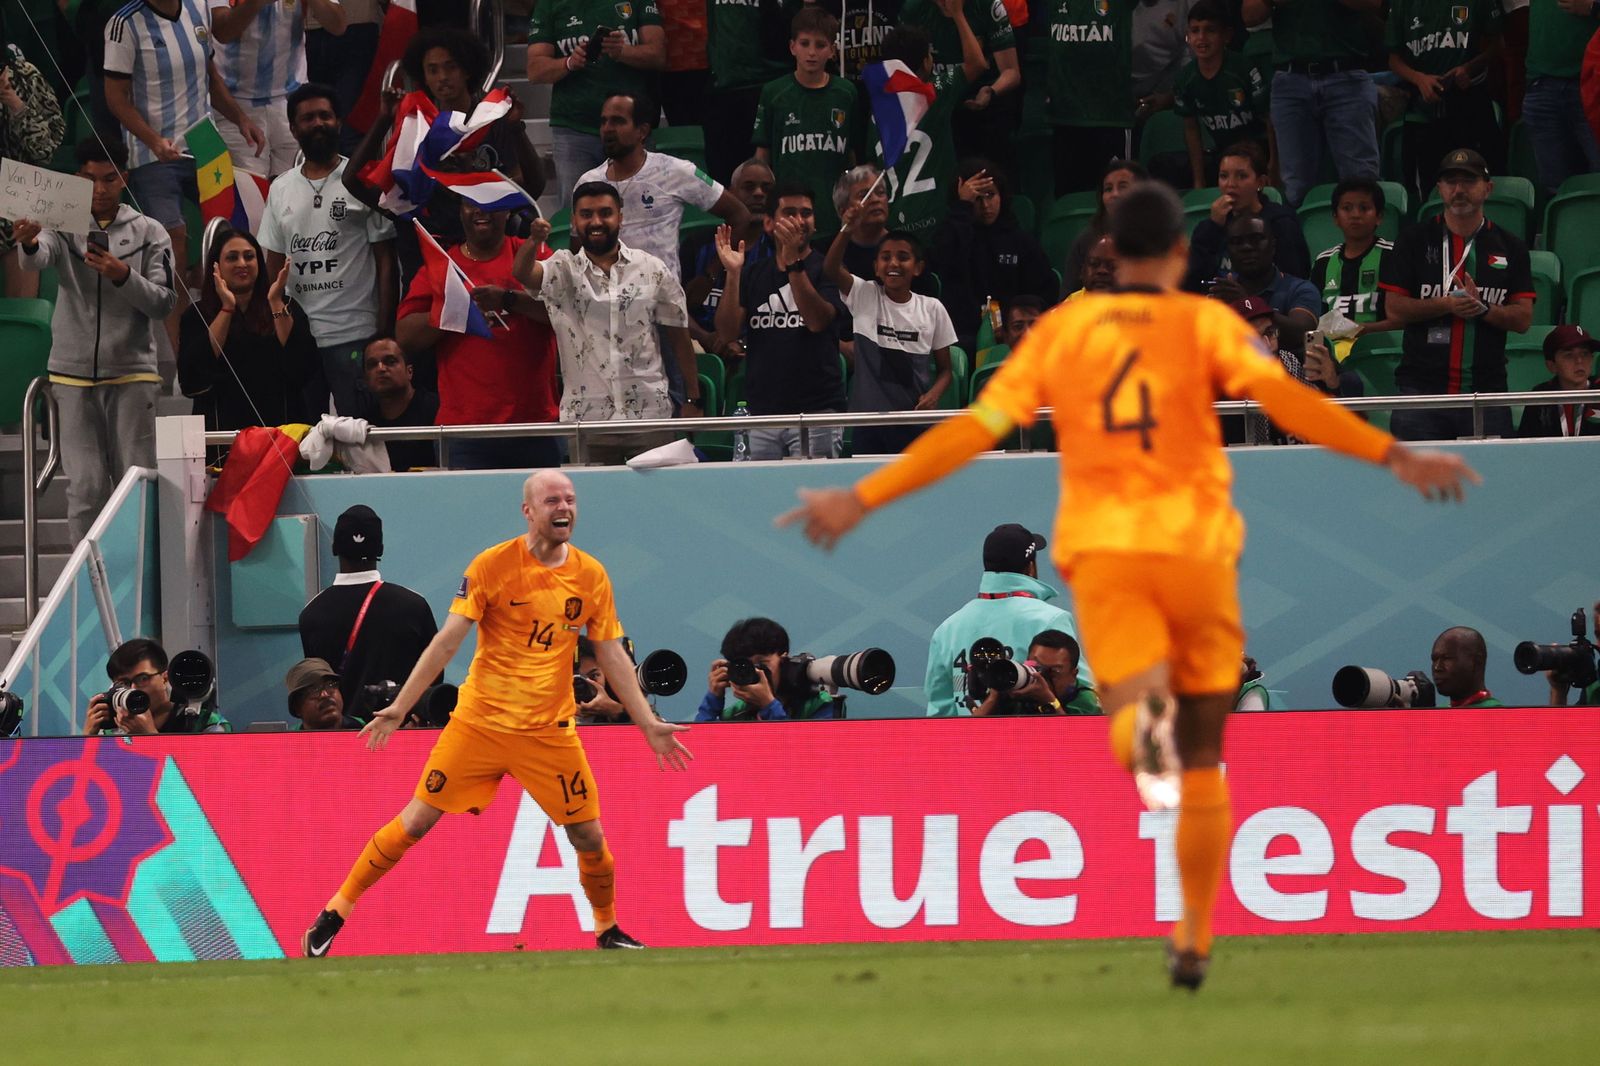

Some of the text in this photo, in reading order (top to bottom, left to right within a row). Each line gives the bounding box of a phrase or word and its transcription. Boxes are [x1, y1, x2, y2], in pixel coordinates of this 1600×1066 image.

[557, 26, 639, 56] YUCN
[1203, 111, 1253, 131] CATÁN
[295, 259, 339, 276] YPF
[303, 281, 344, 292] BINANCE
[1420, 284, 1507, 305] PAINE
[750, 311, 805, 329] adidas
[1102, 350, 1157, 453] 4
[527, 619, 555, 651] 14
[557, 770, 588, 804] 14
[485, 753, 1600, 934] A true esti
